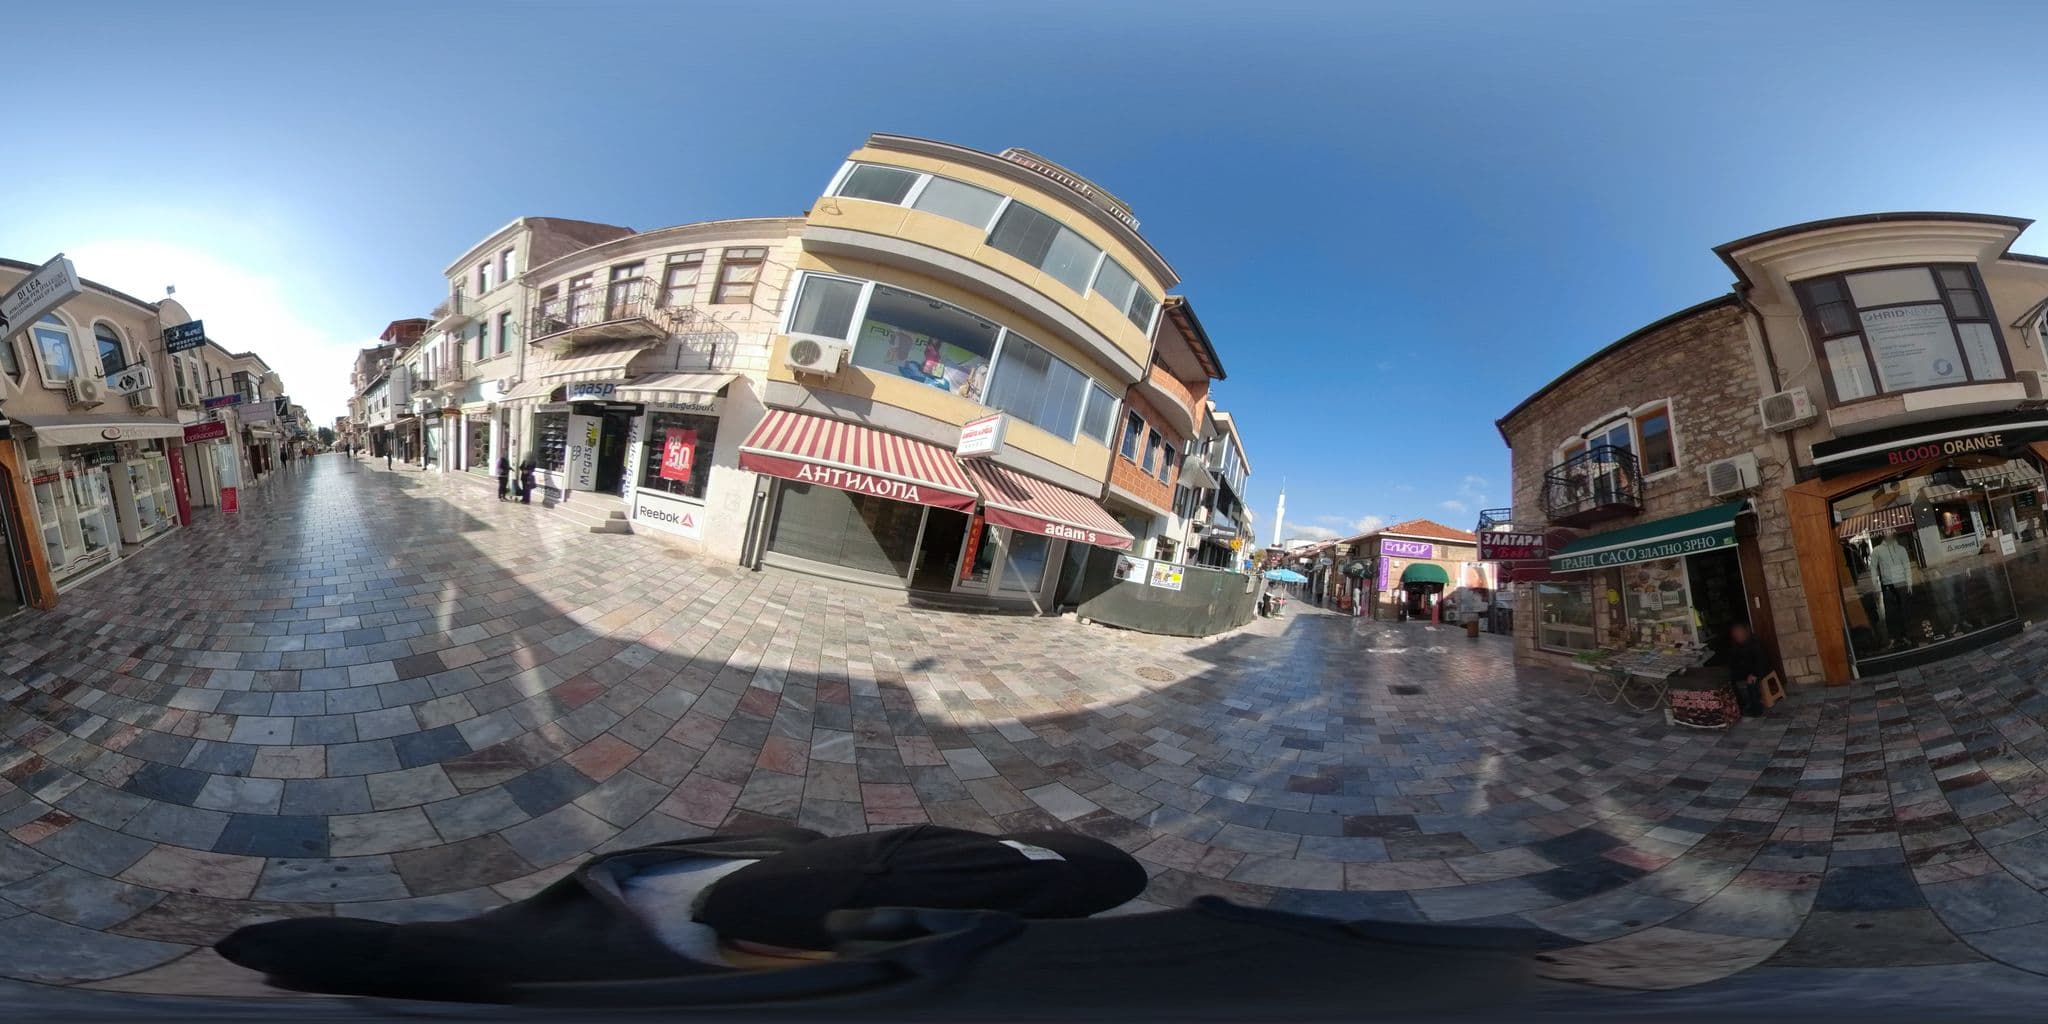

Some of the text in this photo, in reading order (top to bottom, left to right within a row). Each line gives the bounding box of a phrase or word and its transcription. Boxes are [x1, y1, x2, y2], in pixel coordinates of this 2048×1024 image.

[17, 290, 26, 300] DI
[26, 279, 41, 293] LEA
[574, 382, 615, 396] egasp
[580, 421, 596, 486] Megasort
[669, 446, 690, 470] 50
[1888, 434, 2003, 465] BLOOD ORANGE
[796, 463, 920, 502] АНТИЛОПА
[640, 505, 680, 525] Reebok
[1045, 522, 1097, 543] adam's
[1561, 536, 1716, 570] ГРАНД САСО ЗЛАТНО ЗРНО
